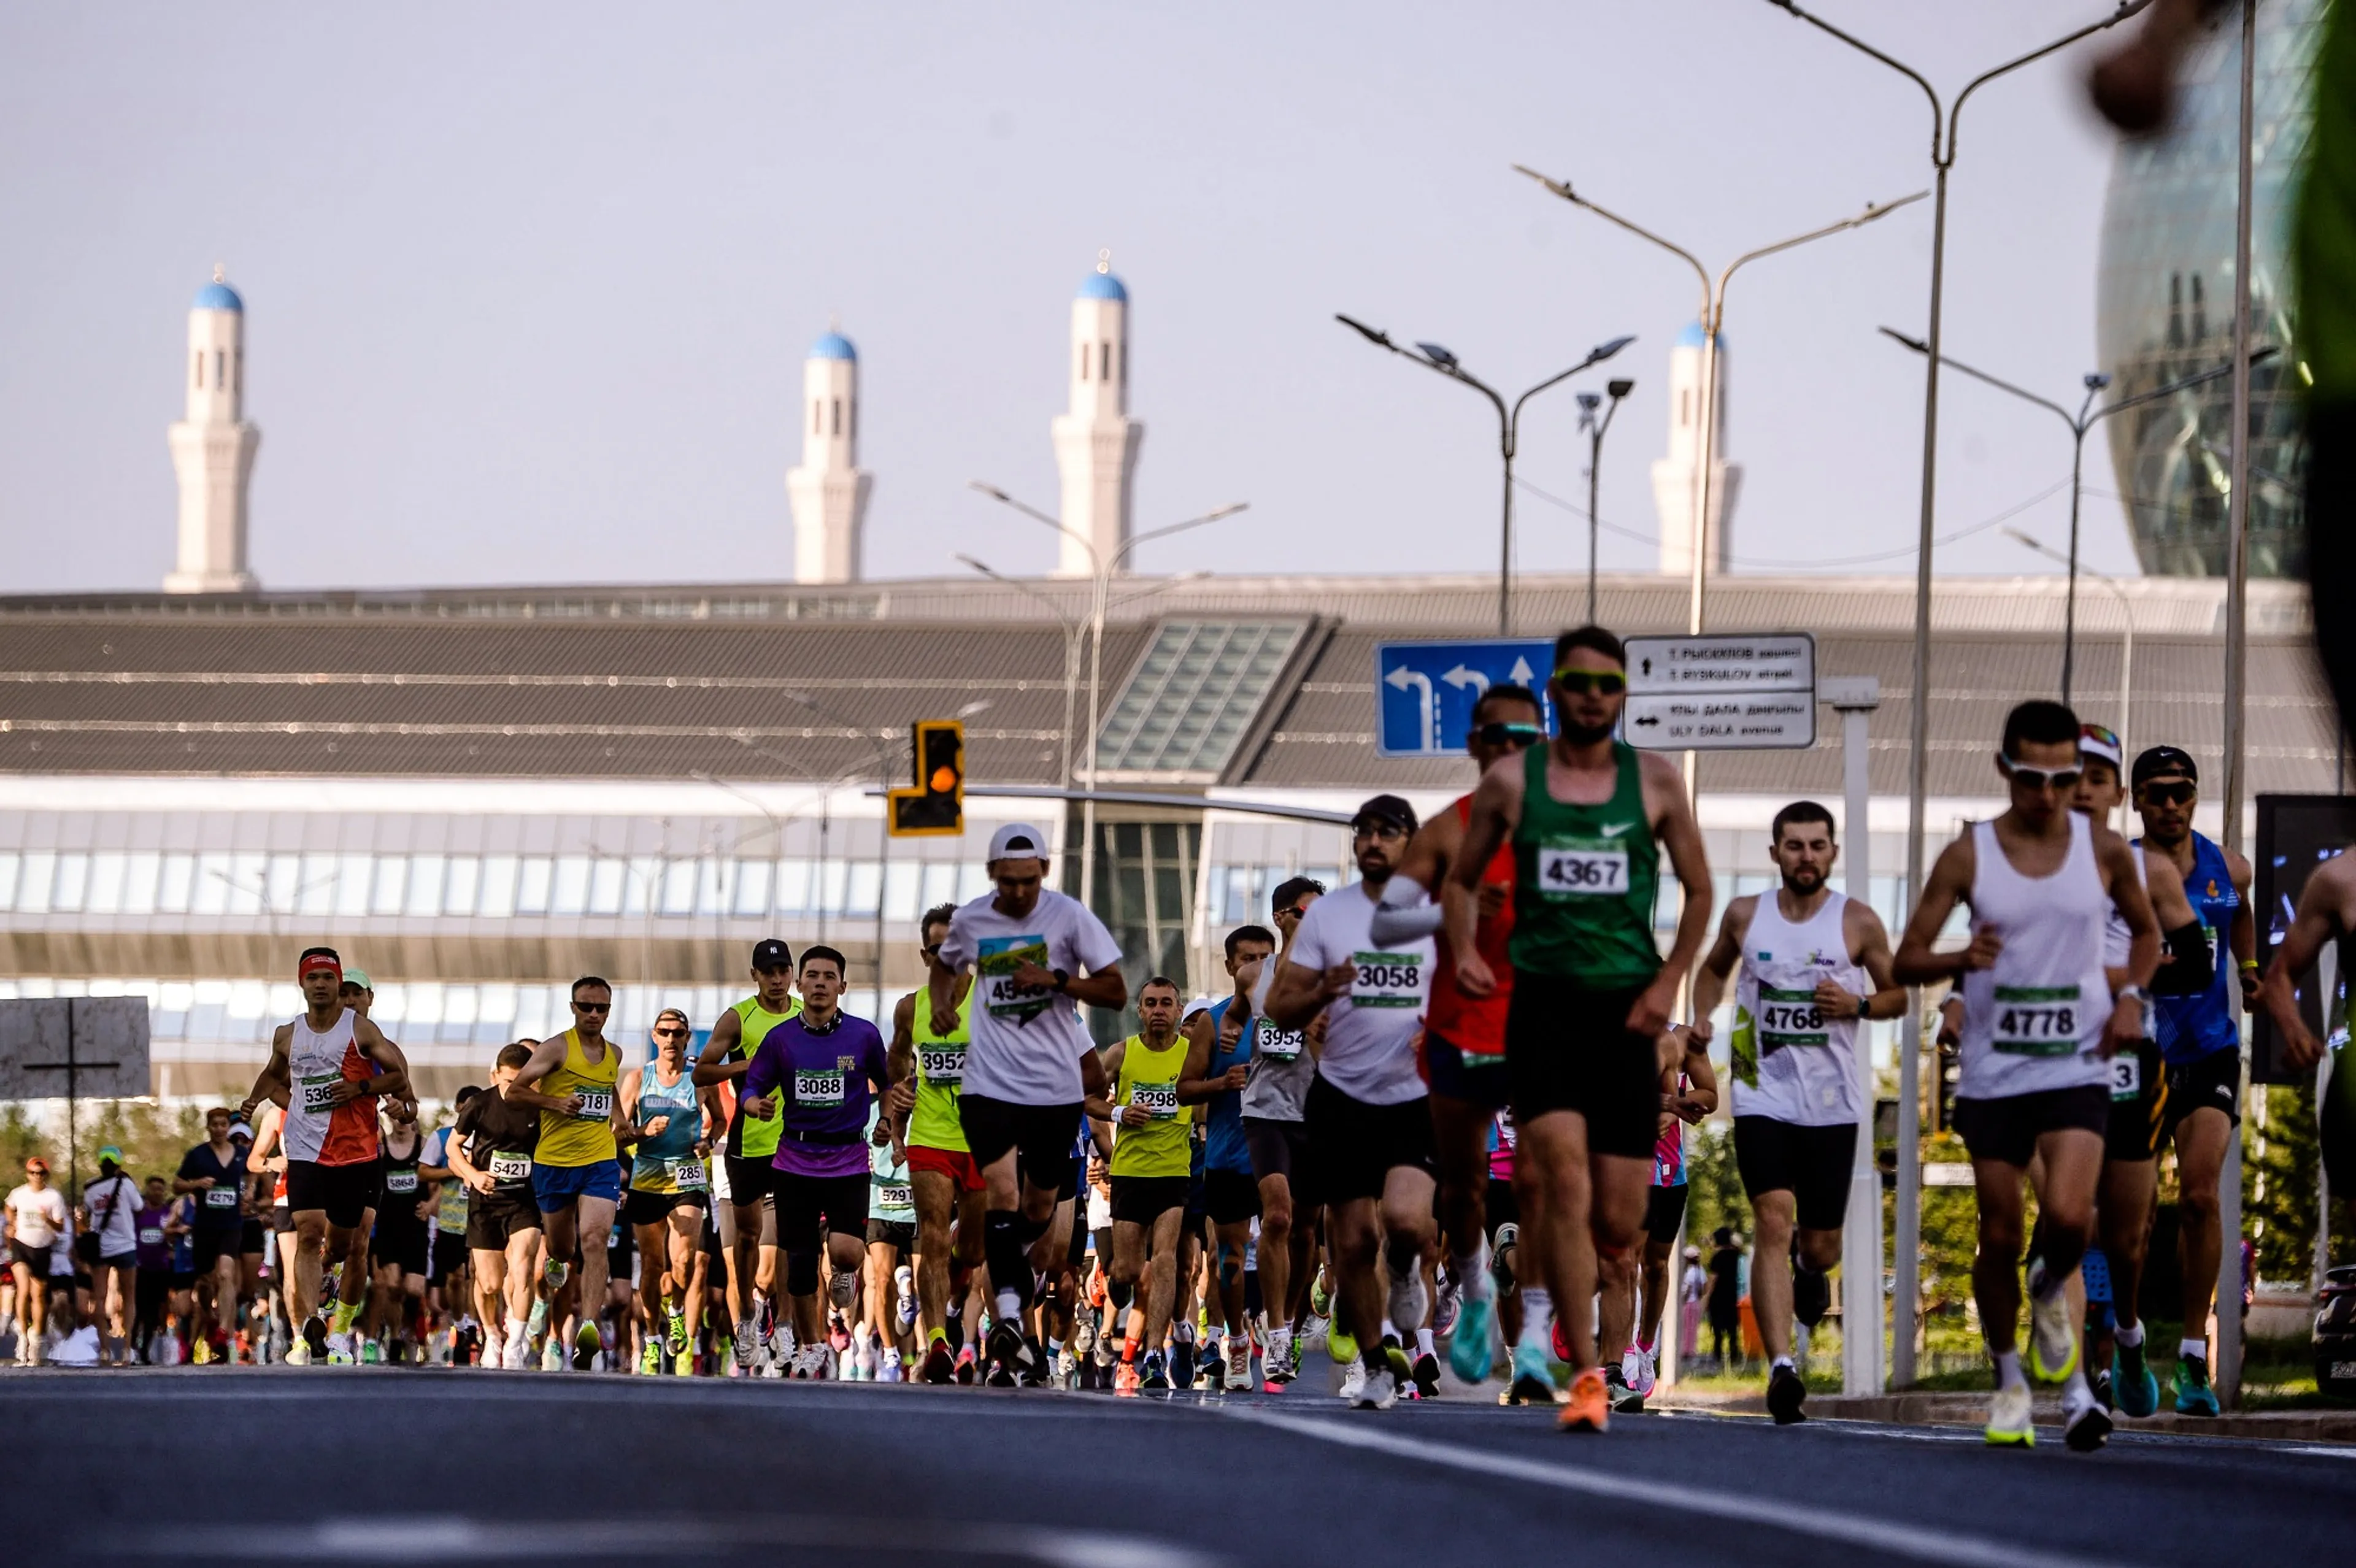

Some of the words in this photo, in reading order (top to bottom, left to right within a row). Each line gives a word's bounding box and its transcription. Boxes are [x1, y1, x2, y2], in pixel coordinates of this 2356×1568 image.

[1547, 858, 1620, 886] 4367
[1357, 965, 1419, 988] 3058
[1765, 1007, 1823, 1029] 4768
[2000, 1007, 2074, 1036] 4778
[1262, 1029, 1304, 1047] 3954
[922, 1053, 966, 1070] 3952
[305, 1086, 333, 1102] 536
[799, 1079, 841, 1094] 3088
[1135, 1092, 1176, 1107] 3298
[493, 1162, 526, 1176] 5421
[679, 1166, 704, 1180] 2851
[884, 1189, 913, 1201] 5291
